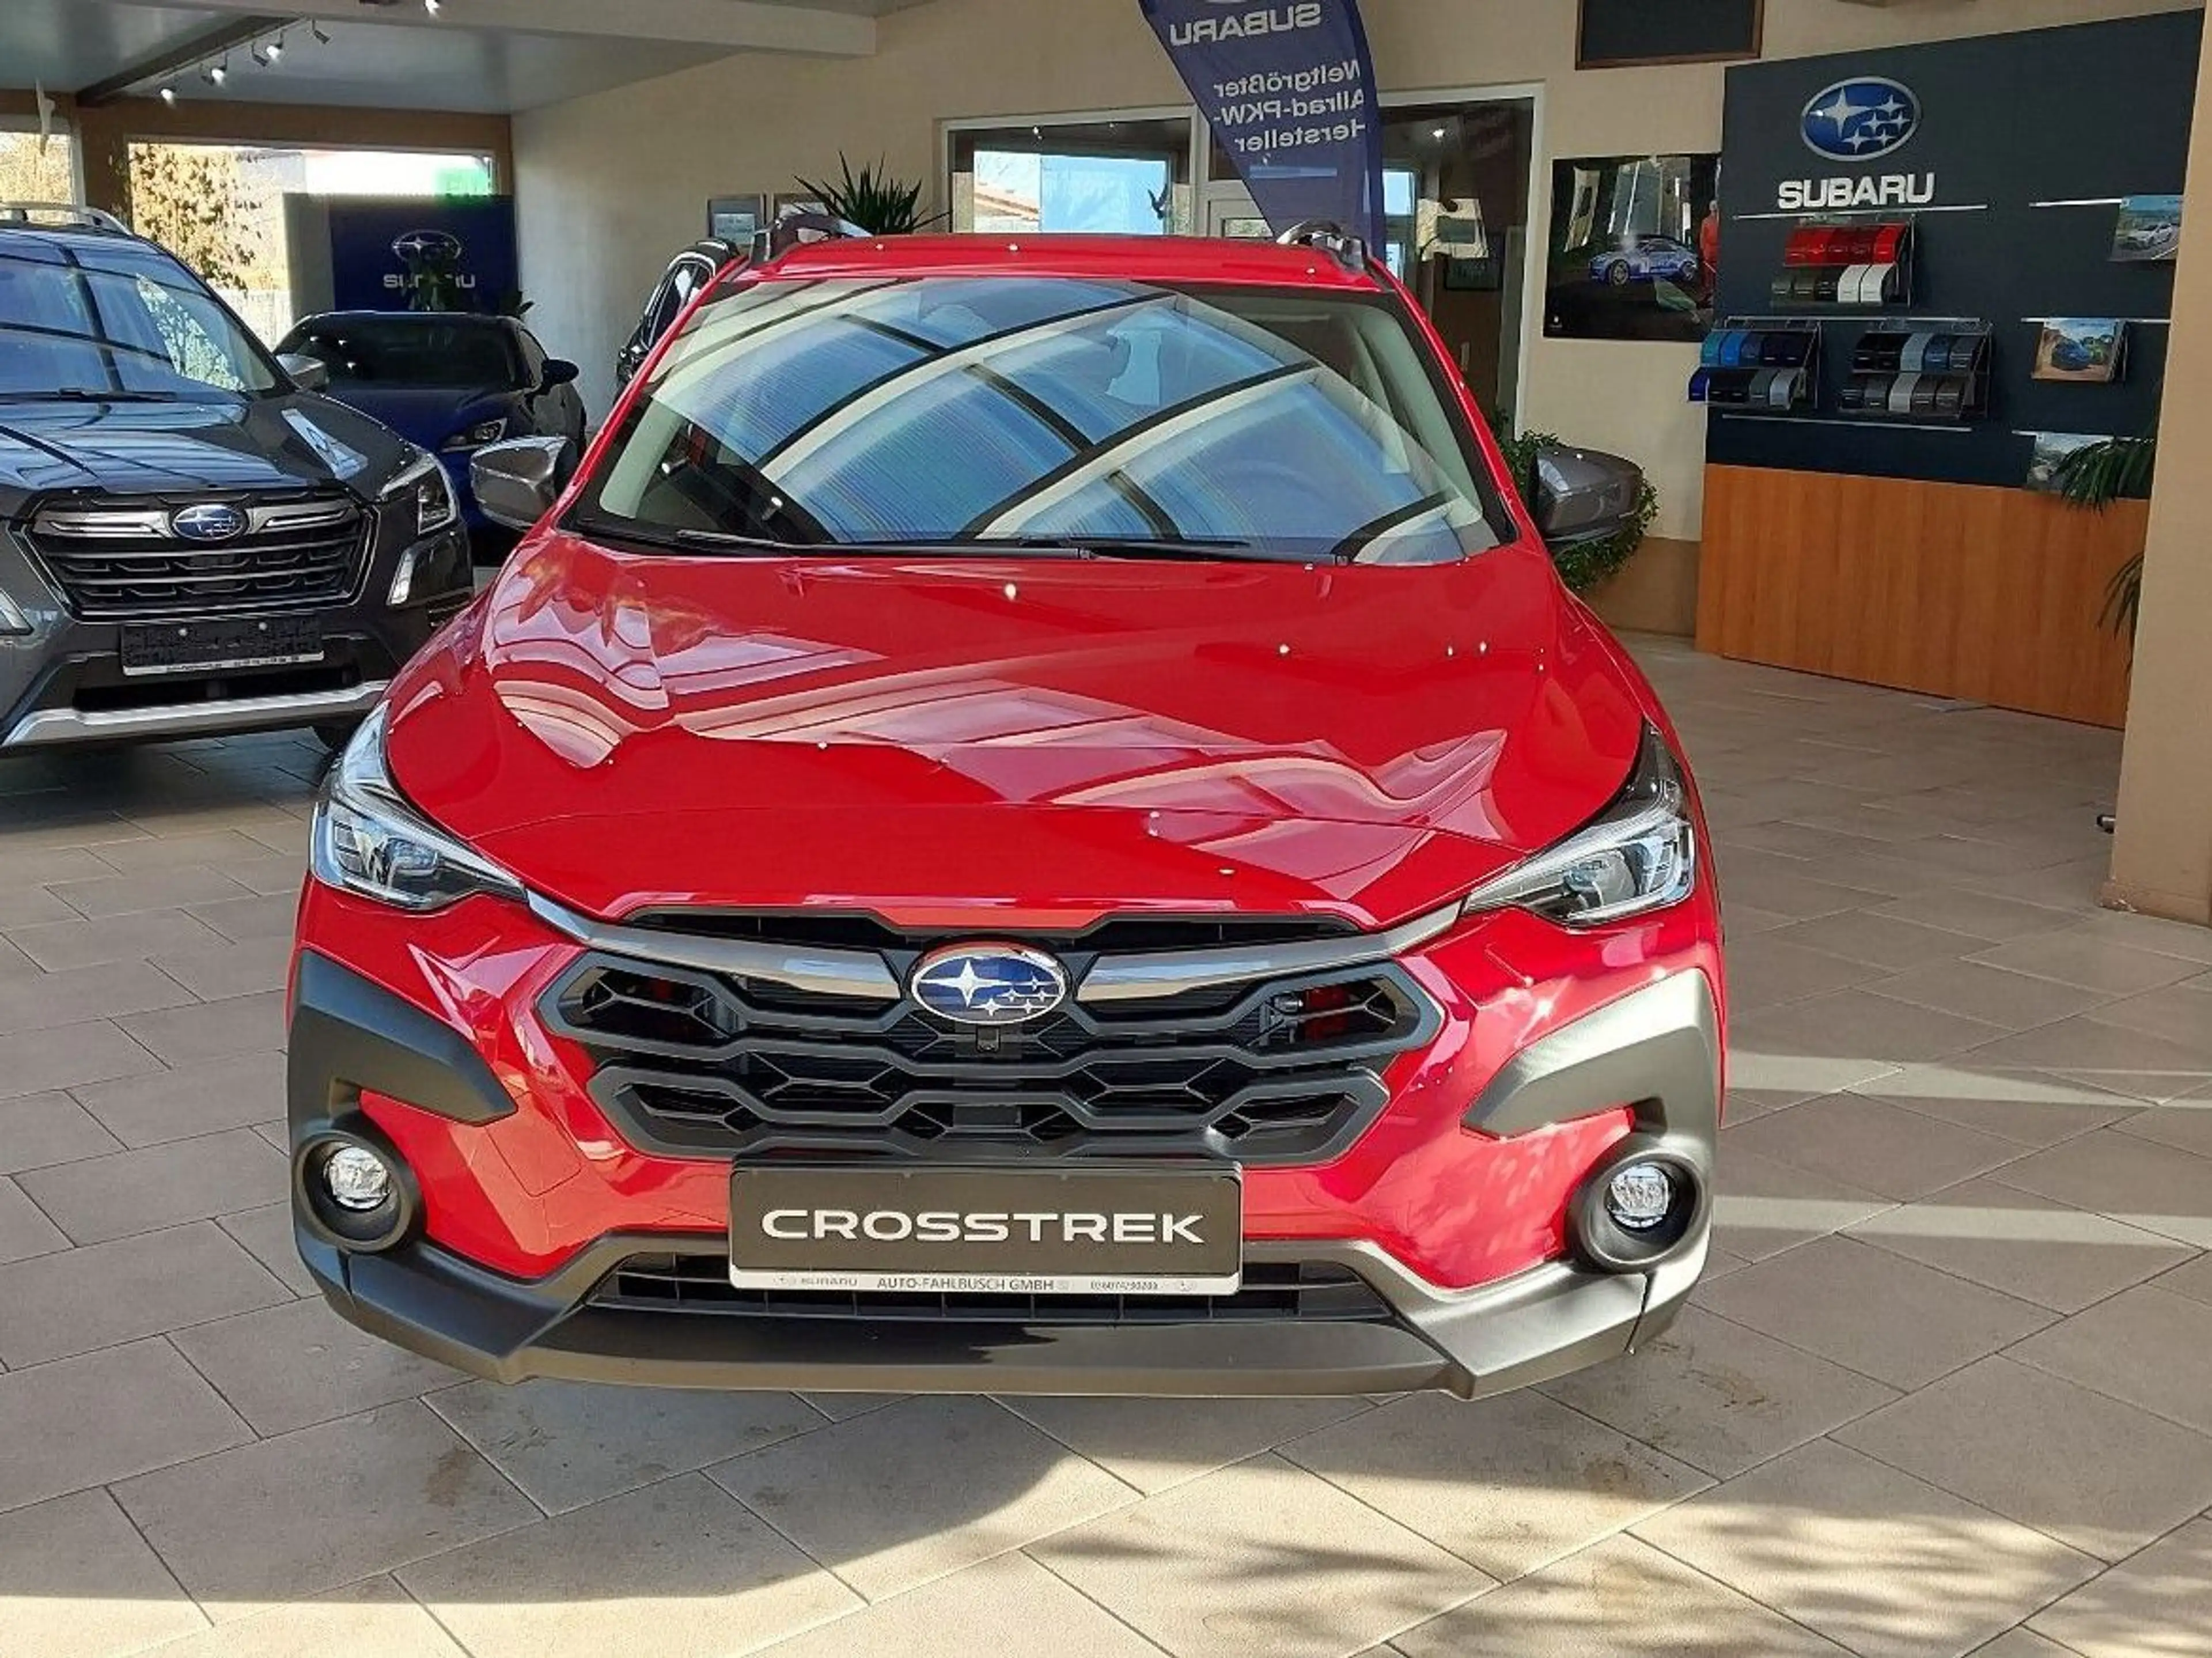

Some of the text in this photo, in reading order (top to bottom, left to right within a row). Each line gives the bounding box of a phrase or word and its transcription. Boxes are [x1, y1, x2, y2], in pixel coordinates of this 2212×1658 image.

[1778, 172, 1935, 209] SUBARU
[383, 274, 476, 289] SUU
[761, 1209, 1206, 1244] CROSSTREK
[877, 1277, 1005, 1290] AUTO-FAHLBUSCH
[1009, 1279, 1055, 1290] GMBH
